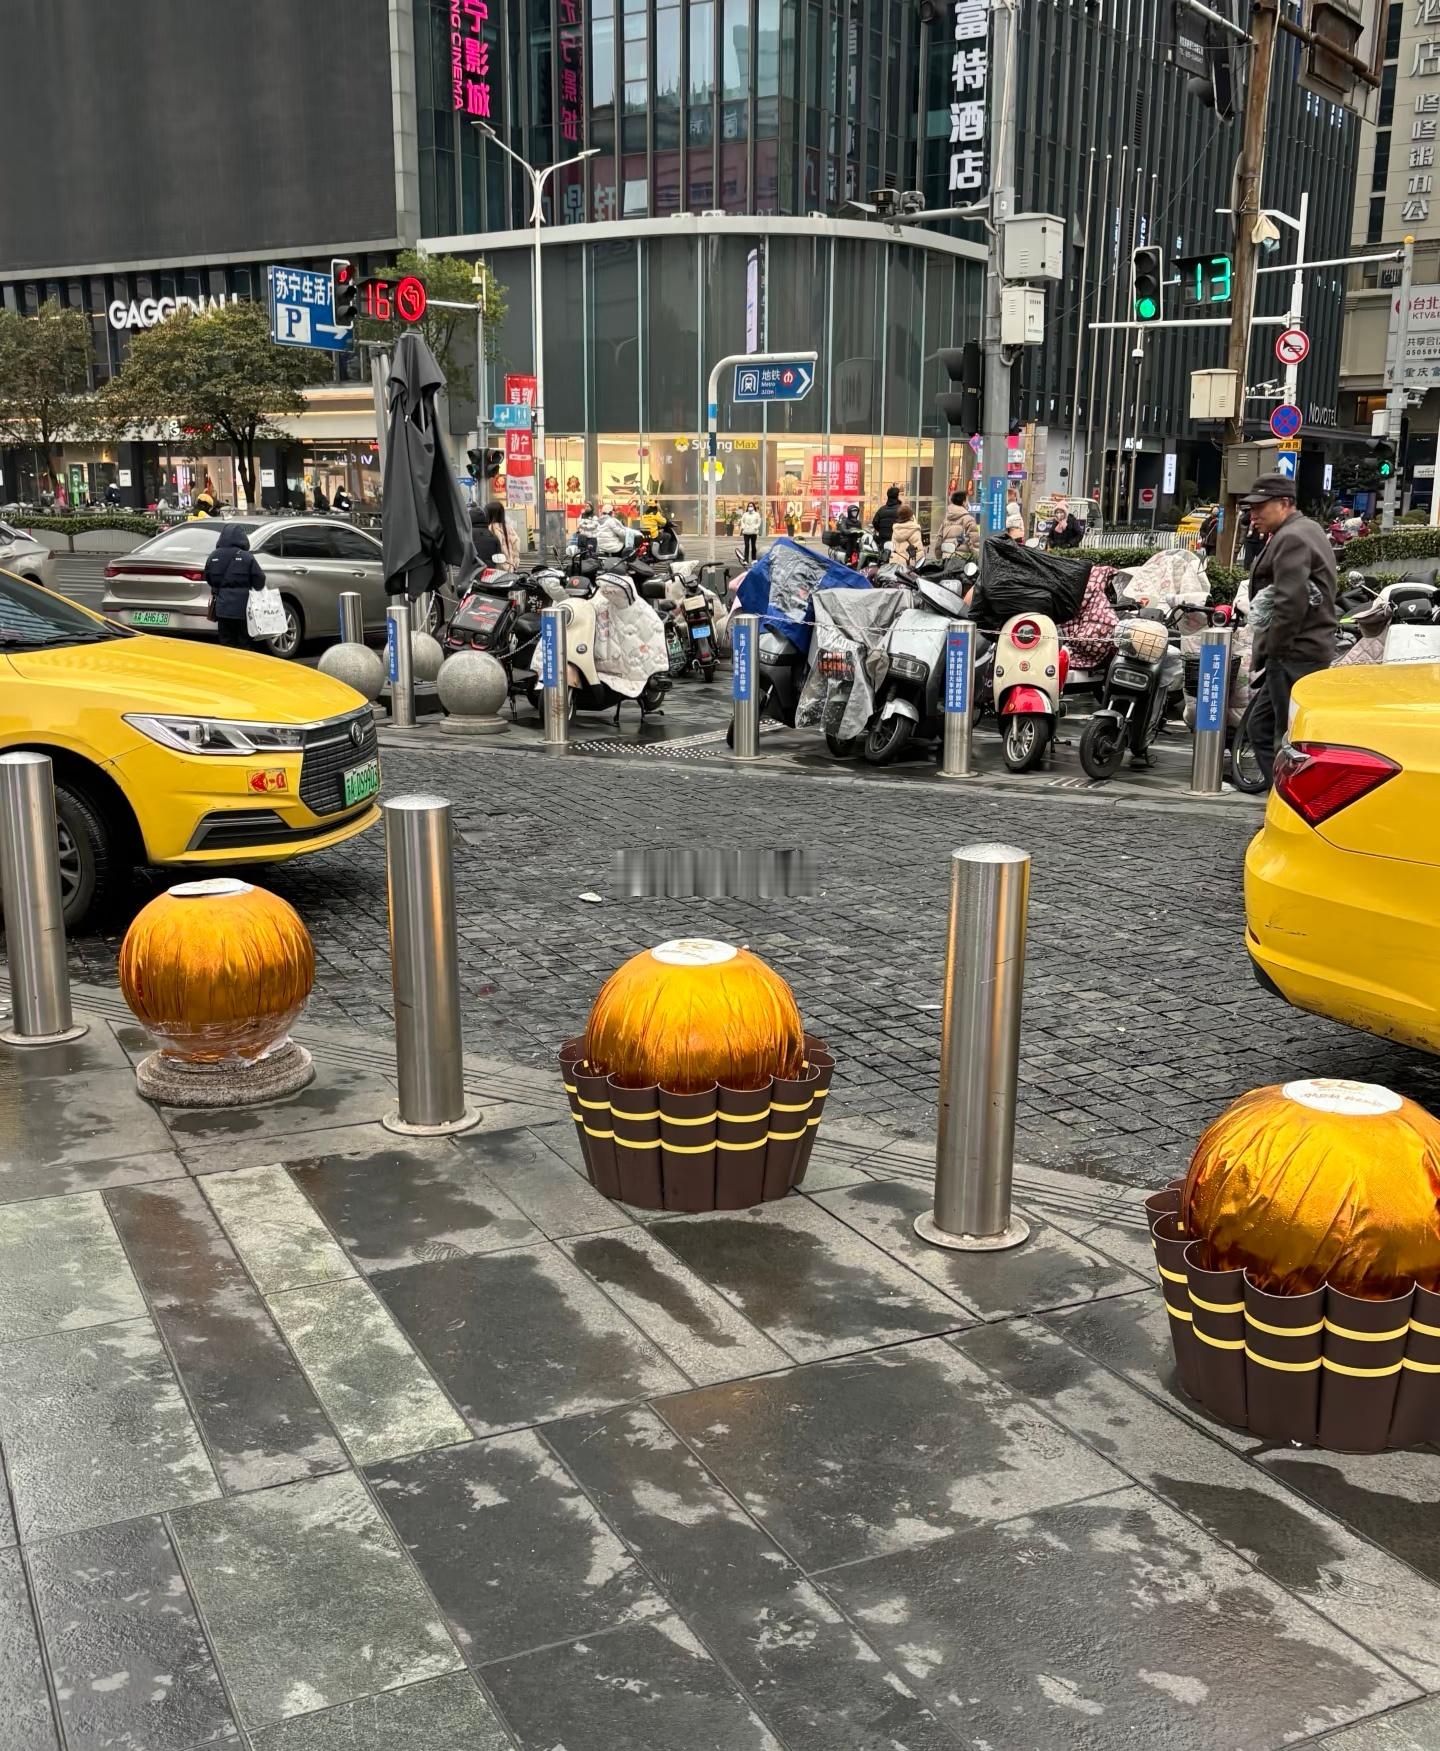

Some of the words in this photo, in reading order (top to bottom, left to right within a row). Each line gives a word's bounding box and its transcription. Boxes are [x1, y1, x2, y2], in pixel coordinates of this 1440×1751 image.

[451, 32, 463, 110] CINEMA
[1196, 257, 1231, 301] 13
[367, 283, 390, 319] 16
[285, 307, 302, 338] P
[761, 369, 780, 381] 地铁
[1308, 401, 1337, 426] NOVOTEL
[691, 439, 733, 453] Sung
[735, 440, 757, 449] Max
[1209, 654, 1221, 722] 车道/广场禁止停车
